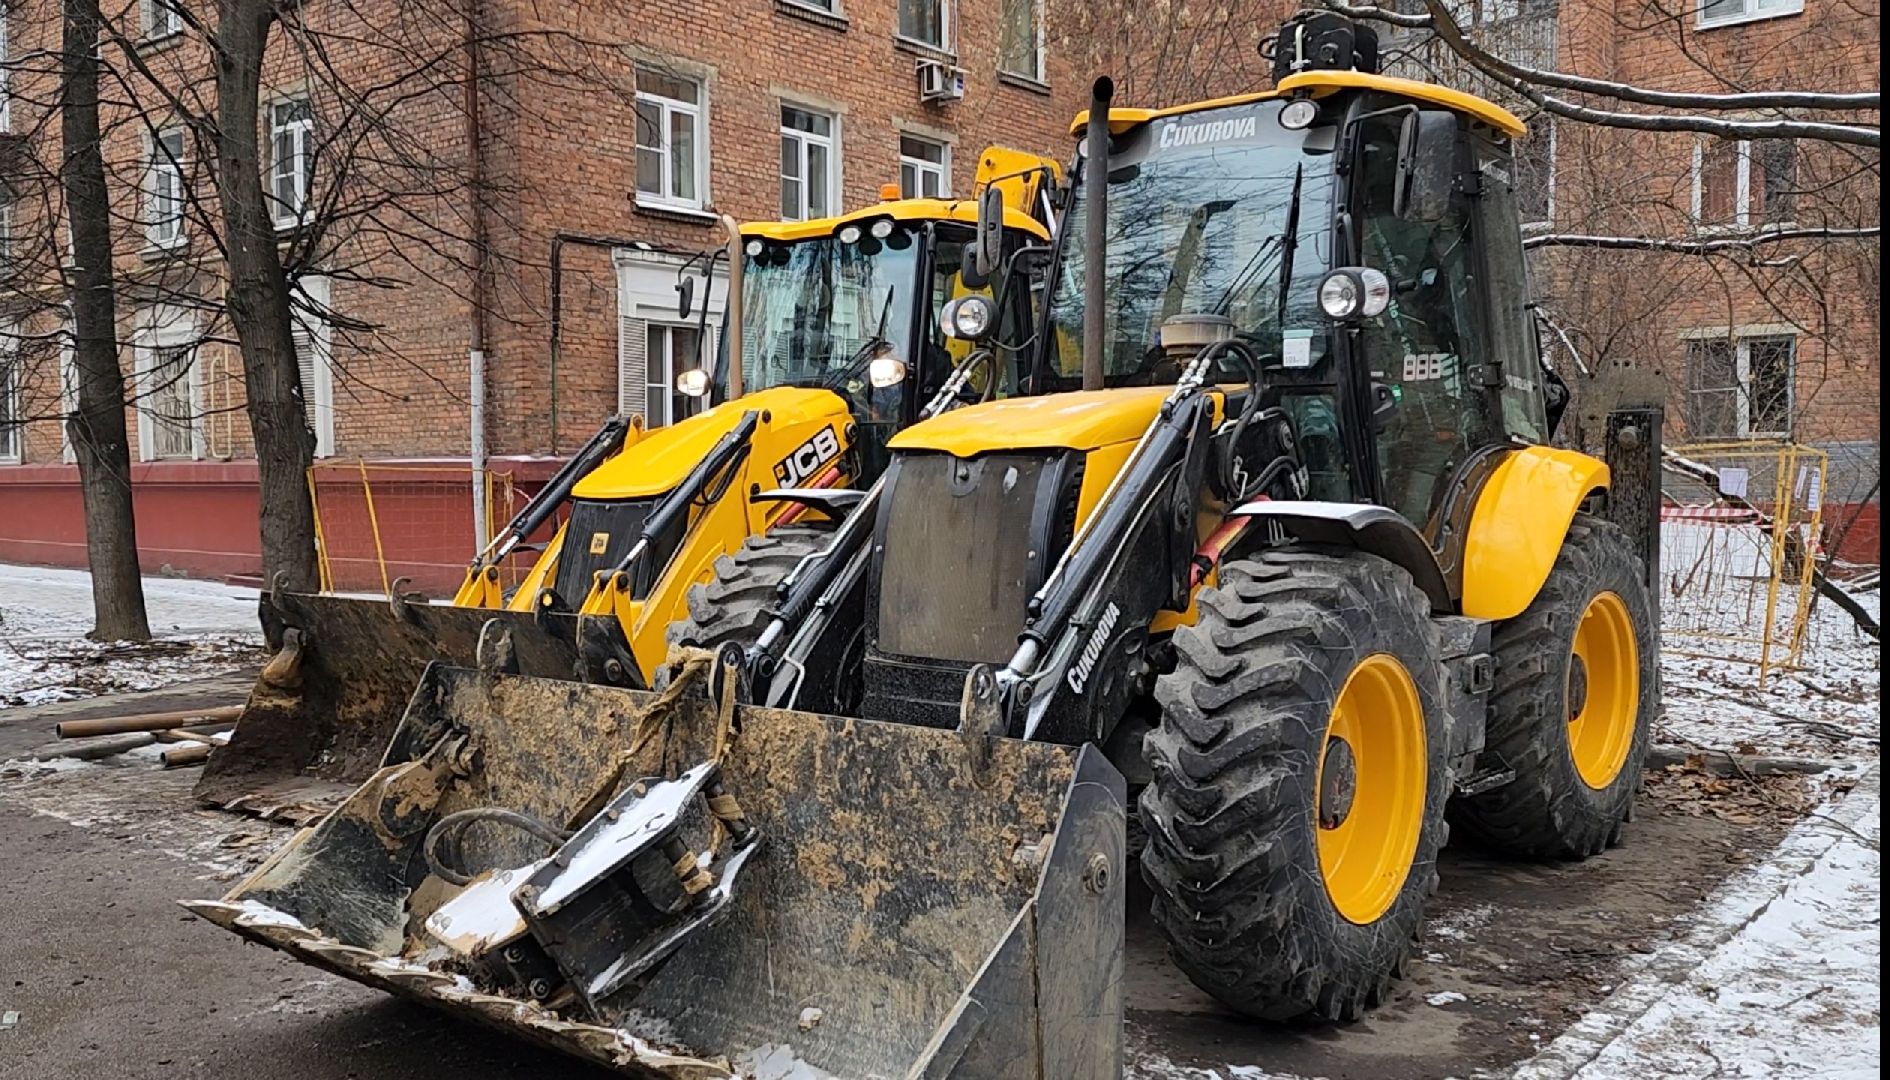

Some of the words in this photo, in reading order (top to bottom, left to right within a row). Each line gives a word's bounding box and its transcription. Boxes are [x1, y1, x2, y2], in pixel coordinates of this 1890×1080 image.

[1160, 117, 1256, 148] CUKUROVA
[780, 428, 838, 489] JCB
[1067, 601, 1120, 694] CUKUROVA
